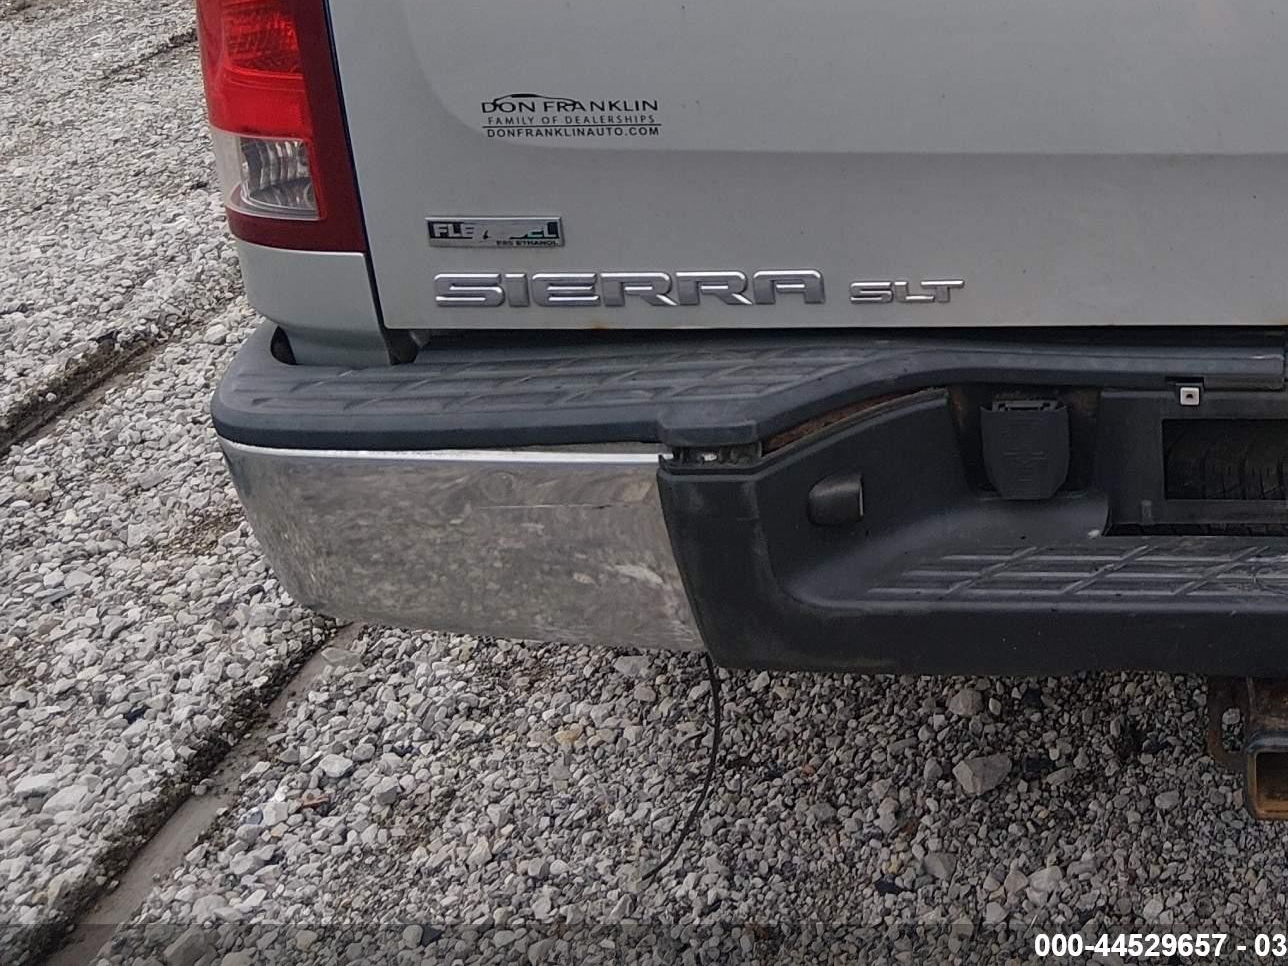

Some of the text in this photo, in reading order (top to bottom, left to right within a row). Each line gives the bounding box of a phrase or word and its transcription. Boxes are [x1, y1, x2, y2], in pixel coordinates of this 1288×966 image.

[481, 100, 659, 114] DON FRANKLIN
[488, 114, 656, 126] FAMILY OF DEALERSHIPS
[487, 126, 660, 138] DONFRANKLINAUTO.COM
[433, 269, 965, 308] SIERRA SLT
